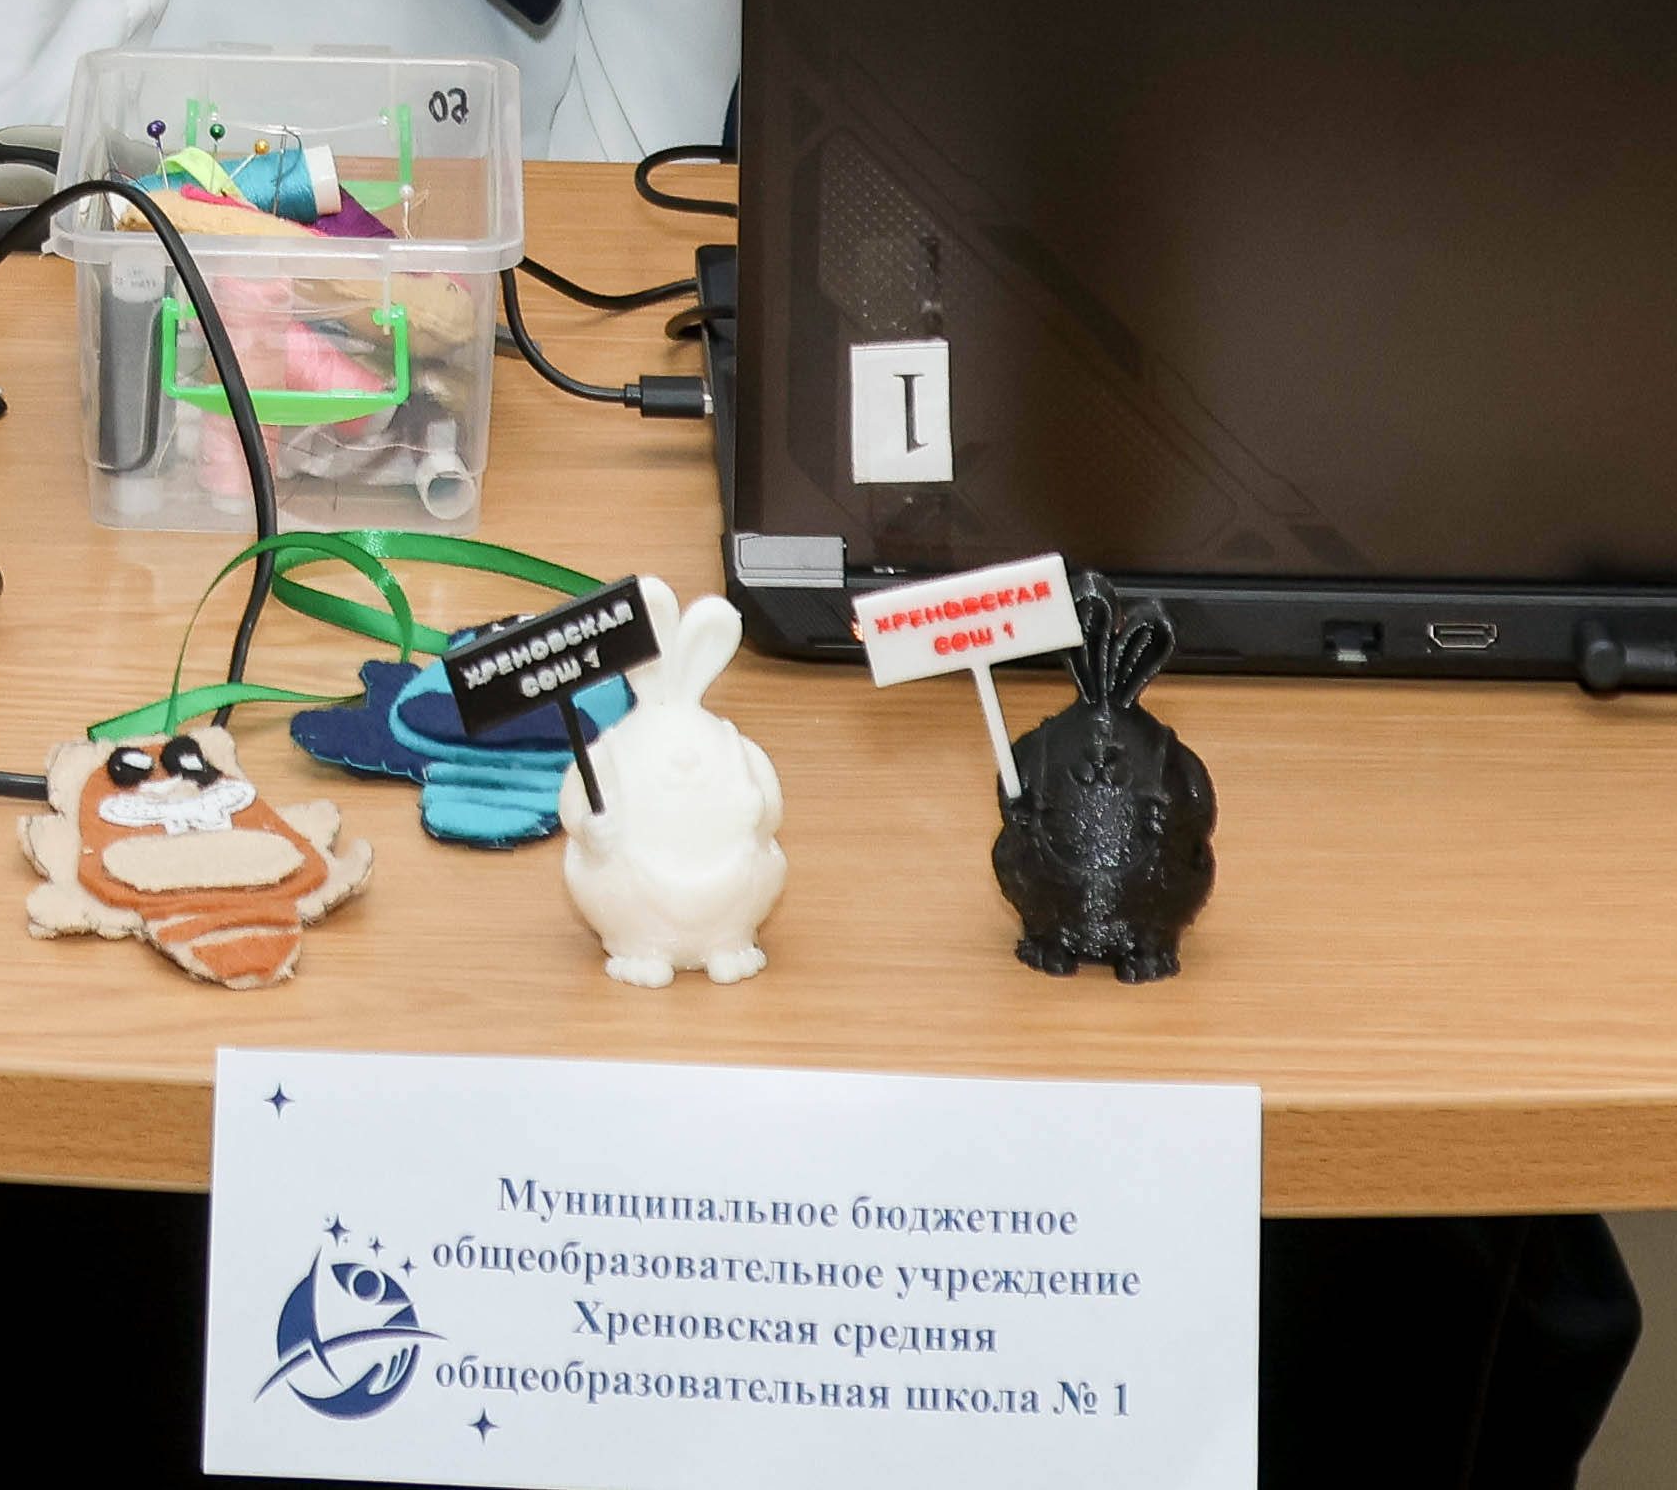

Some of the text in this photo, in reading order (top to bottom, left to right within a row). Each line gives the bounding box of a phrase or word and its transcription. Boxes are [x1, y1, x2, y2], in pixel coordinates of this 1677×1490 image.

[874, 580, 1052, 634] ХРЕНОВСКАЯ
[460, 599, 634, 690] ХРЕНОВСКАЯ
[933, 620, 1016, 656] СОШ 1
[520, 643, 601, 698] СОШ 1
[496, 1175, 1079, 1236] Муниципальное бюджетное
[432, 1235, 1143, 1302] общеобразовательное учреждение
[573, 1299, 999, 1358] Хреновская средняя
[435, 1354, 1131, 1417] общеобразовательная школа № 1
